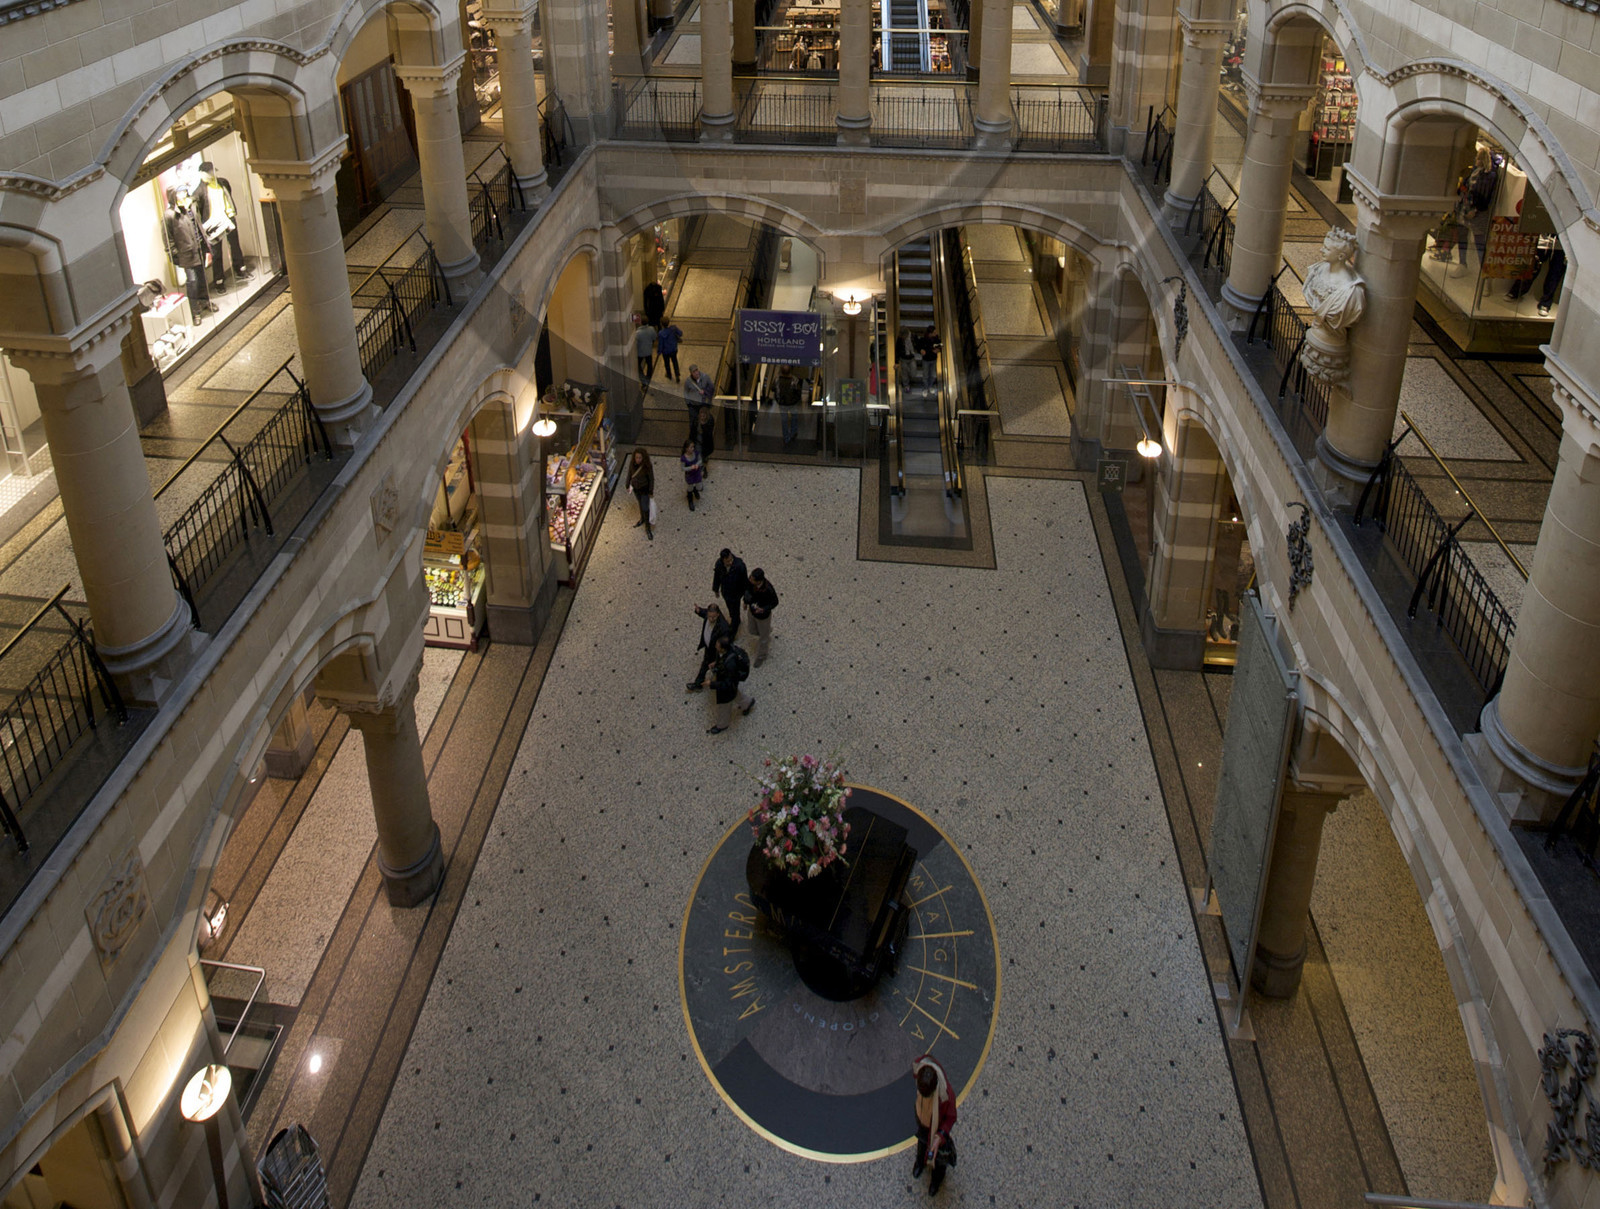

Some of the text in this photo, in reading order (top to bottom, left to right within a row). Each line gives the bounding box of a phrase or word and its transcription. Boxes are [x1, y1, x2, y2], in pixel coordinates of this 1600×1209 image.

[1490, 235, 1539, 244] HERFST
[757, 337, 805, 345] HOMELAND
[761, 356, 801, 364] Basement
